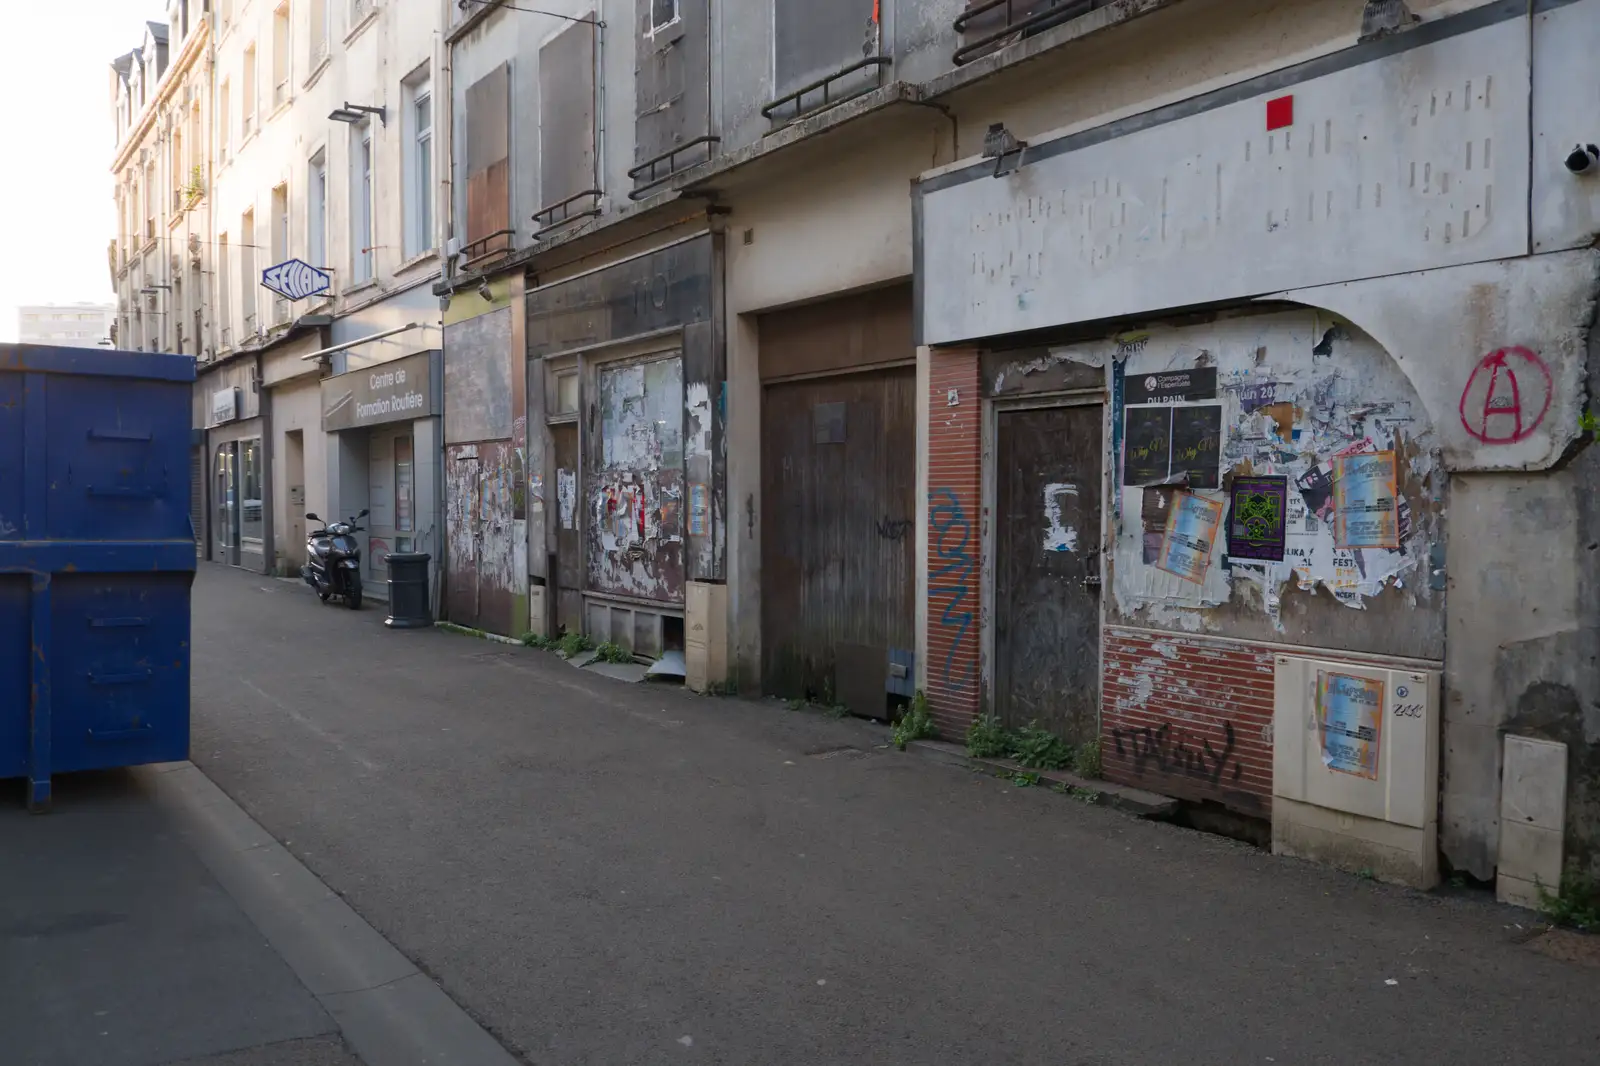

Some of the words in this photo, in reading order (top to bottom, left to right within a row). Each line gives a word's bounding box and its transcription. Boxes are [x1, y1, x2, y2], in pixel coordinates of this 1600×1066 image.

[370, 372, 394, 390] Centre
[395, 368, 406, 384] de
[1157, 373, 1190, 383] Compagnie
[1163, 394, 1186, 404] PAIN
[356, 397, 390, 419] Formation
[391, 390, 423, 412] Routière
[1346, 437, 1373, 454] cert
[1283, 547, 1306, 557] LIKA
[1332, 558, 1357, 568] FEST
